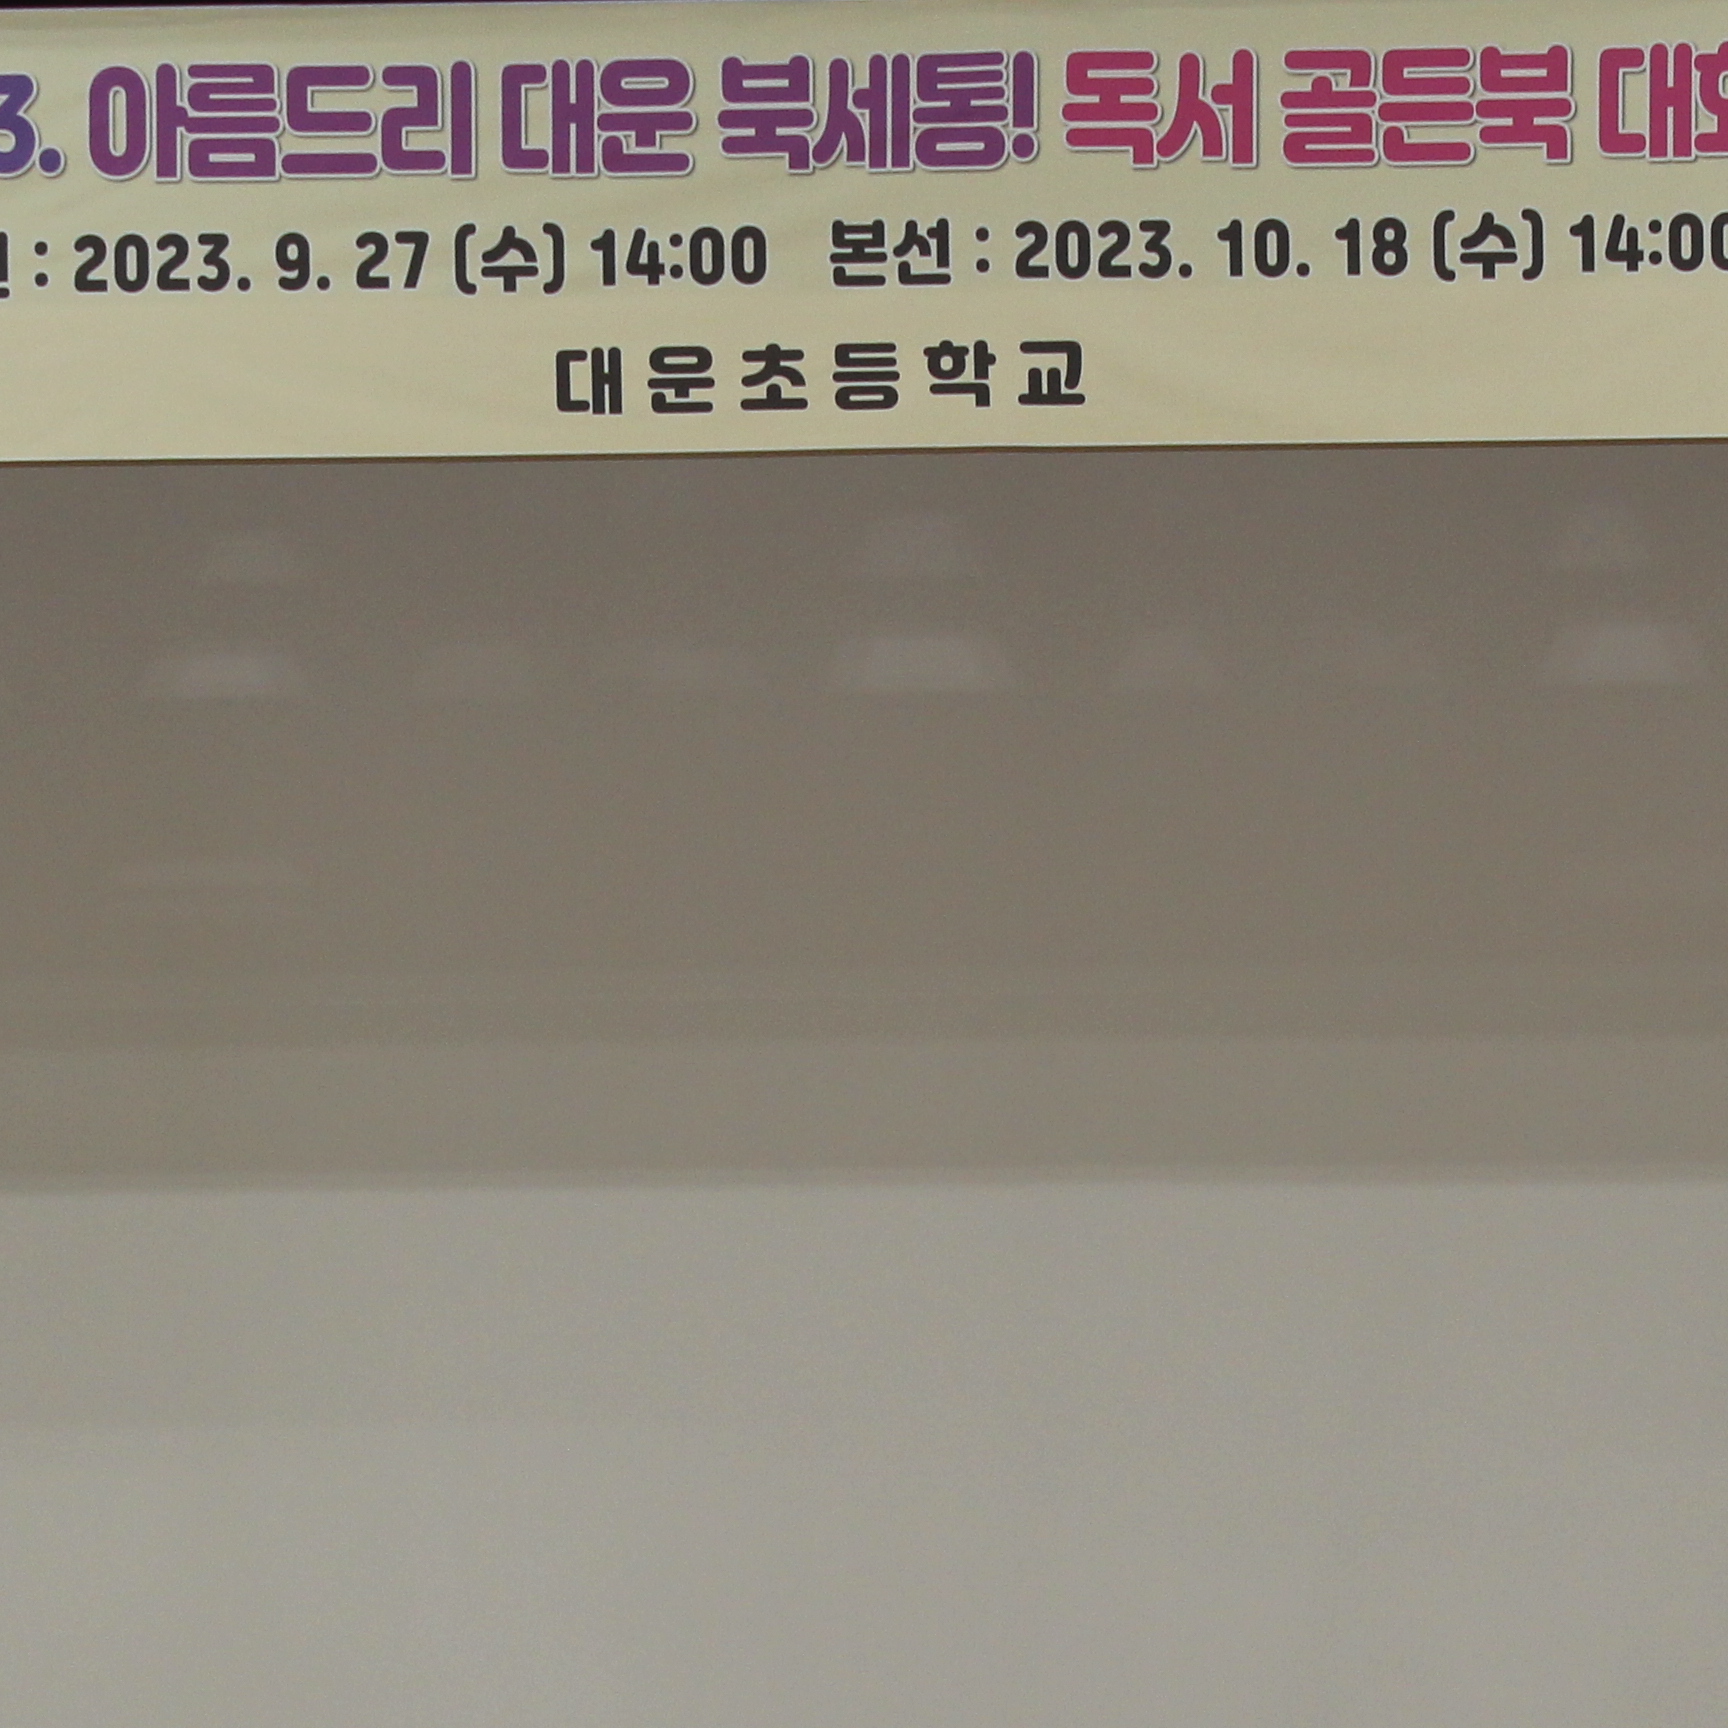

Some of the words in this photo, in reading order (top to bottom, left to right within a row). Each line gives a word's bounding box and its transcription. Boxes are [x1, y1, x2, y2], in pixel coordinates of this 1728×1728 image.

[87, 60, 473, 178] 아름드리
[499, 57, 693, 174] 대운
[716, 50, 1036, 175] 북세통!
[1059, 46, 1255, 170] 독서
[1278, 43, 1573, 165] 골든북
[73, 233, 251, 292] 2023.
[274, 231, 331, 290] 9.
[354, 230, 430, 289] 27
[589, 225, 767, 286] 14:00
[828, 217, 952, 287] 본선
[1014, 218, 1193, 279] 2023.
[1216, 217, 1310, 277] 10.
[1333, 216, 1408, 276] 18
[554, 339, 1086, 415] 대운초등학교
